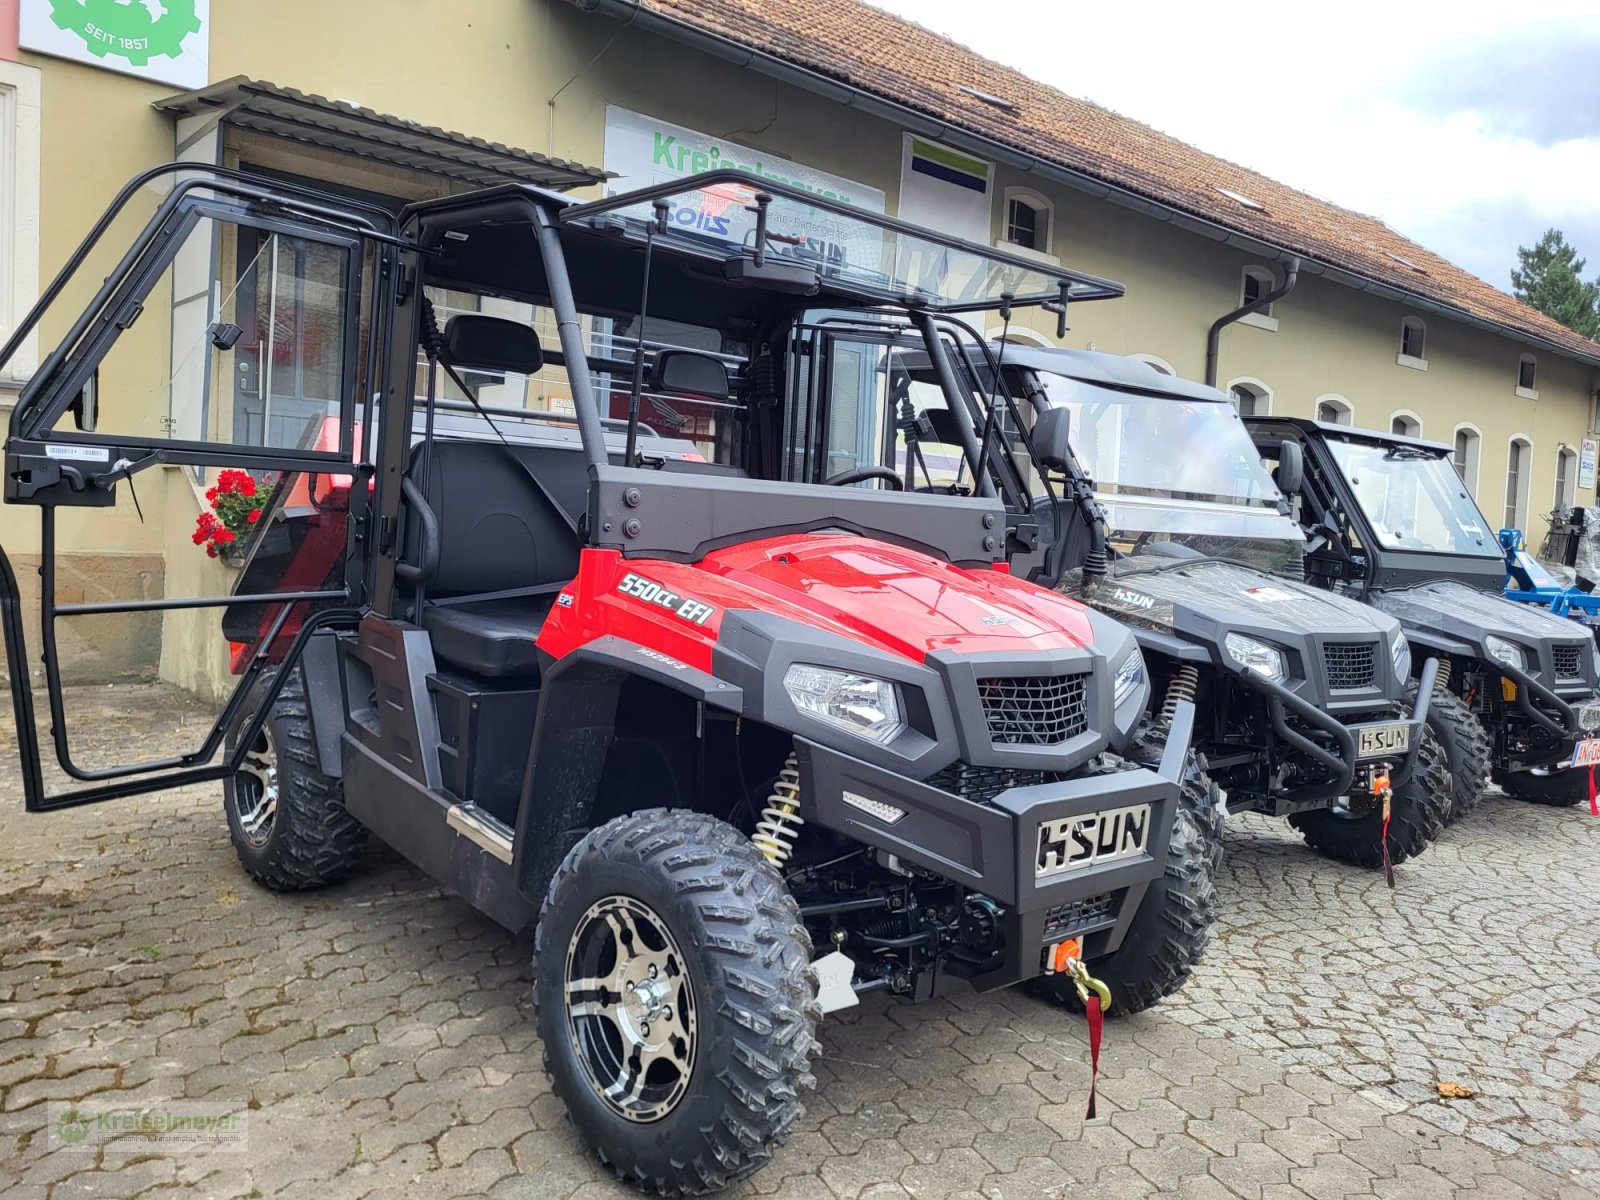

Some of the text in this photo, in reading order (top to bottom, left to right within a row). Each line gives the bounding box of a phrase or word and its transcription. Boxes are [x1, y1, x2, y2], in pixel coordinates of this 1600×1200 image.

[84, 21, 148, 50] SEIT 1857
[557, 593, 574, 606] EPS
[676, 599, 714, 624] EFI
